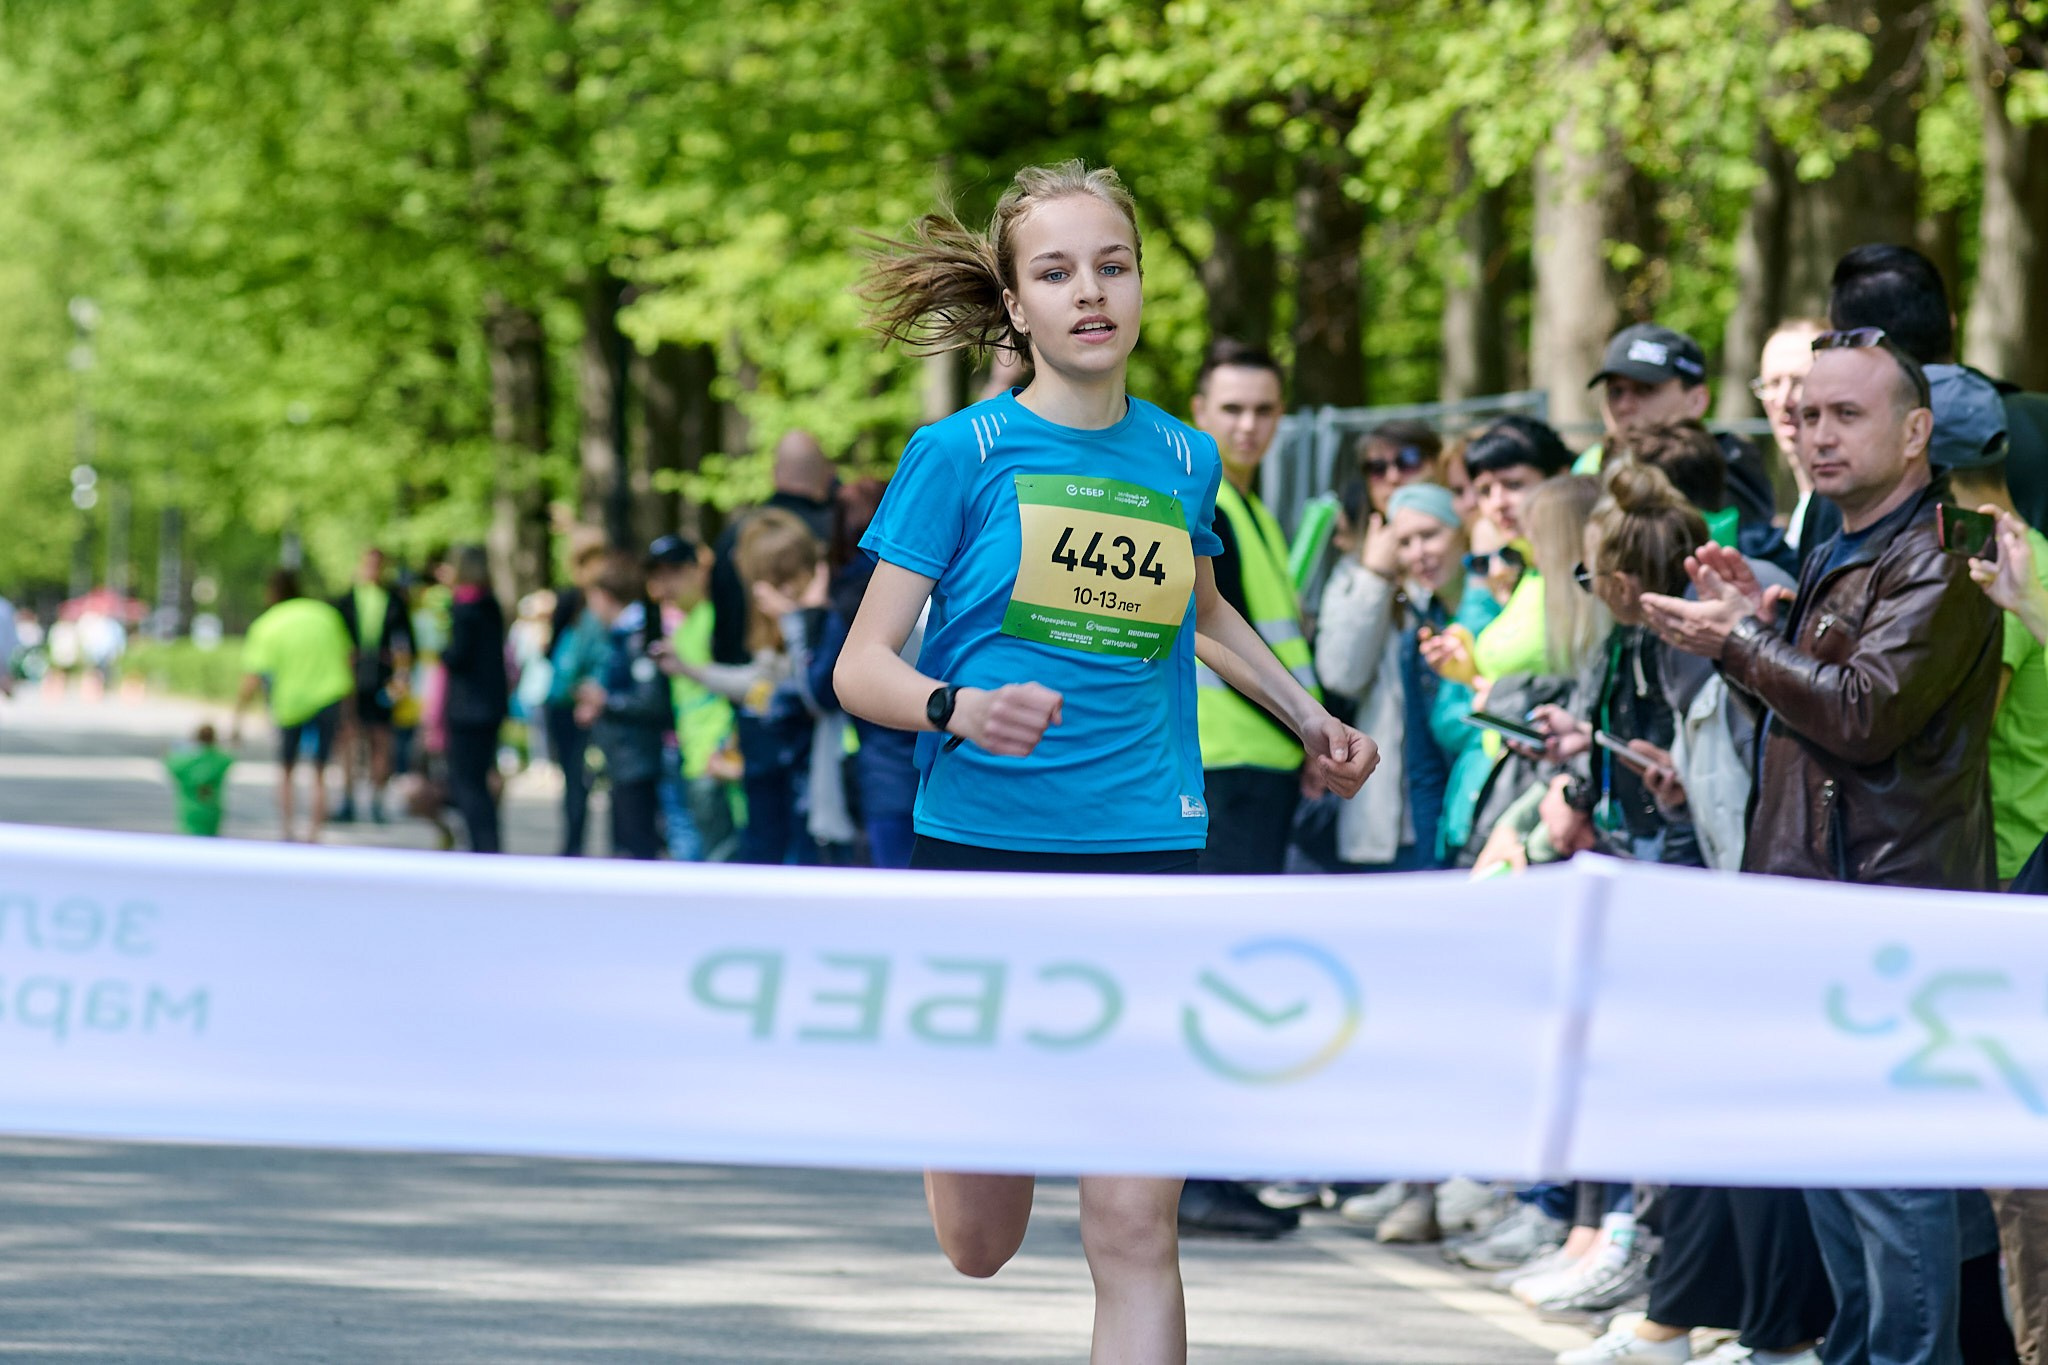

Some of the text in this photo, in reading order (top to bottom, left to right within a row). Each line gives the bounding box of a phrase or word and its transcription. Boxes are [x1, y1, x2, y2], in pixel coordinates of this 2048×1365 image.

[1080, 487, 1104, 497] СБЕР
[1051, 526, 1166, 586] 4434
[1073, 586, 1142, 613] 10-13 лет
[1037, 614, 1077, 627] Перекрёсток
